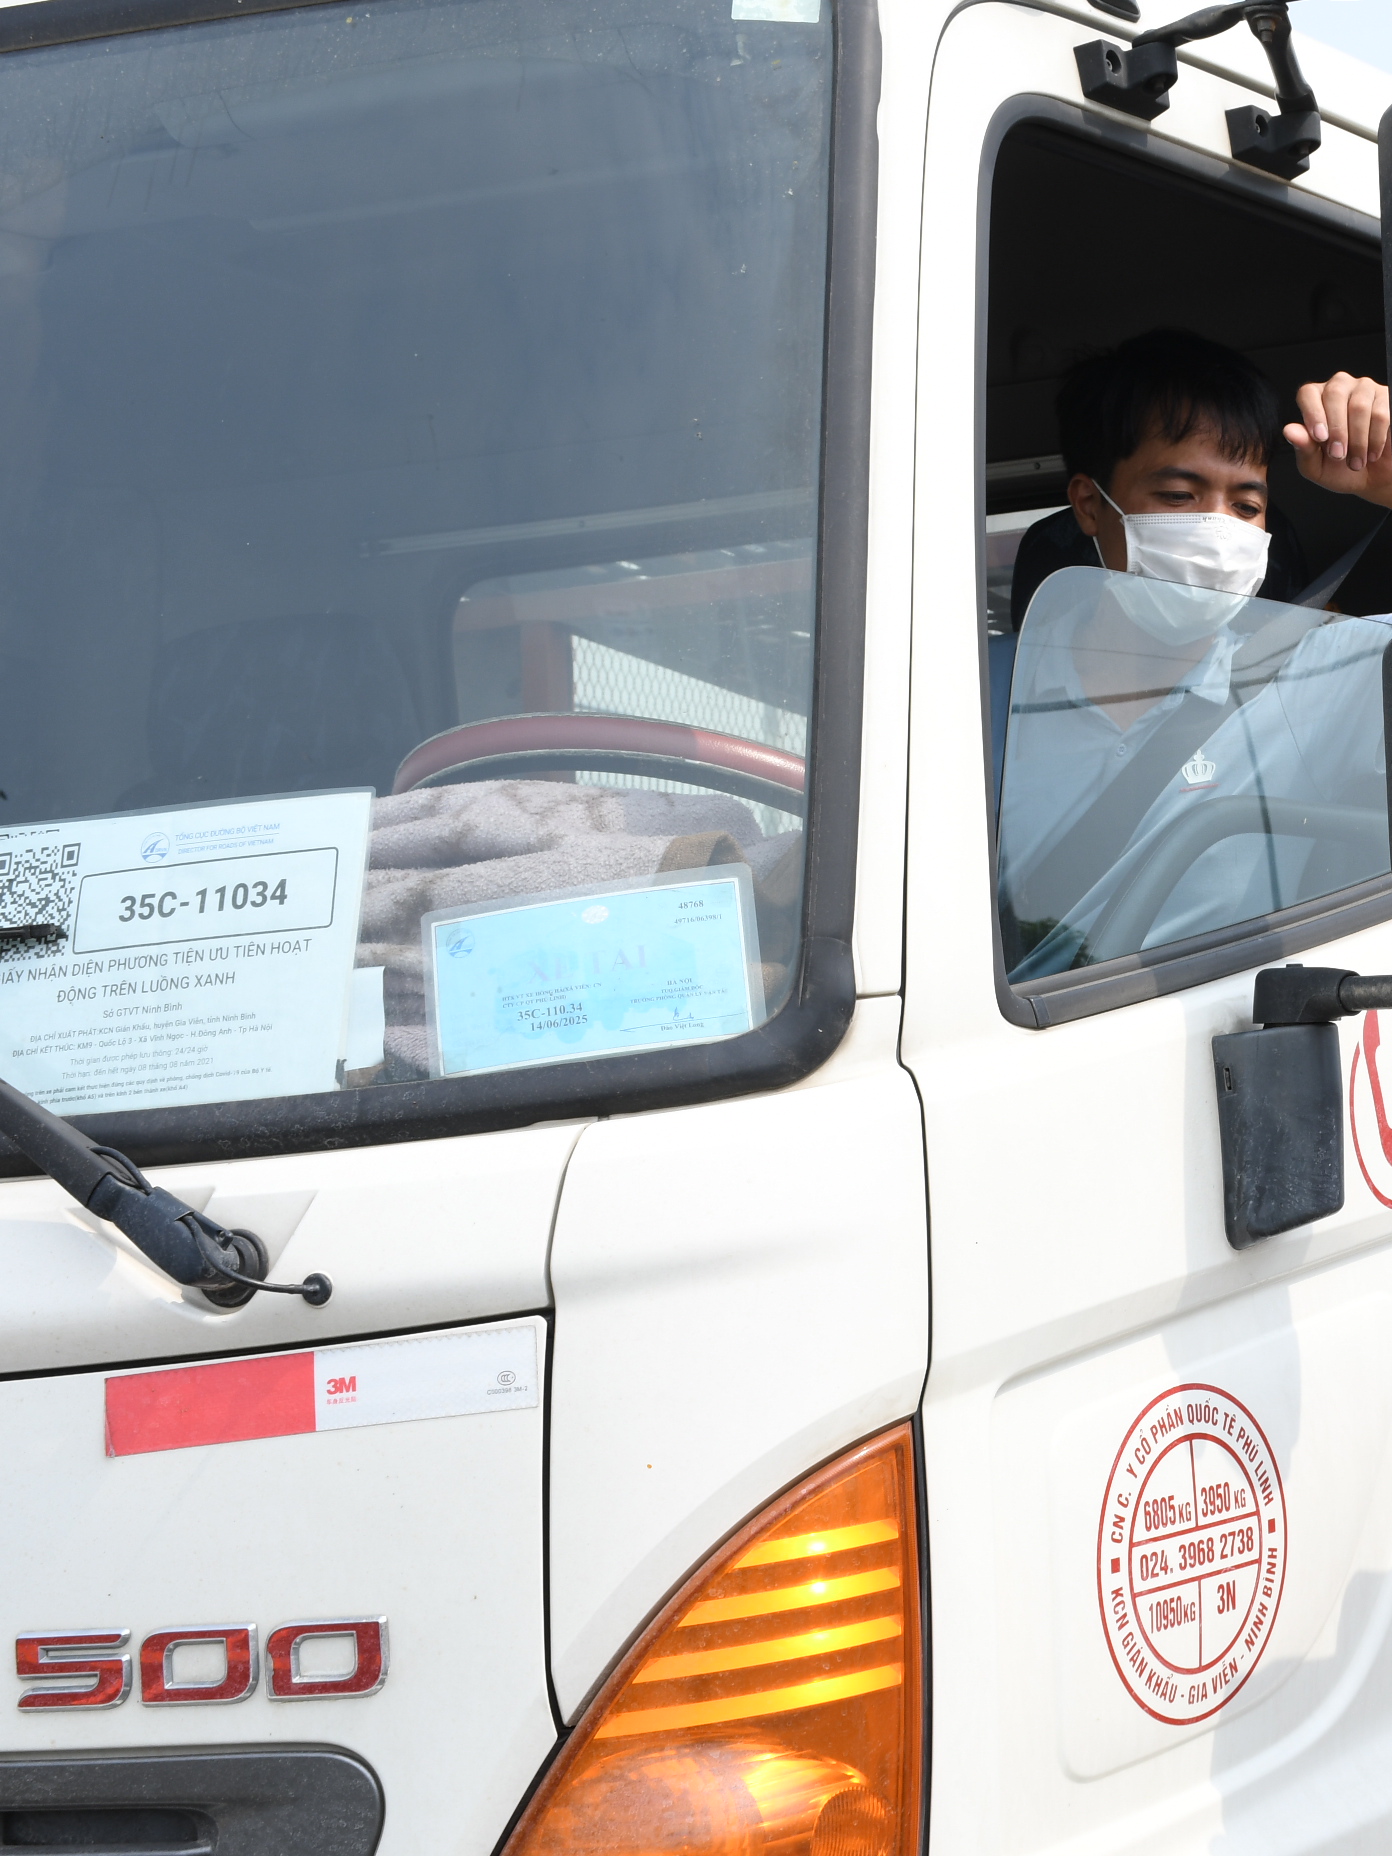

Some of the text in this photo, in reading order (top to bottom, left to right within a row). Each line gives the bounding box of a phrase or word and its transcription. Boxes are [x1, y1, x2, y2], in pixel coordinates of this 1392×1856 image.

[264, 823, 281, 832] NAM
[118, 878, 288, 923] 35C-11034
[677, 899, 705, 910] 48768
[1, 938, 312, 985] IẤY NHẬN DIỆN PHƯƠNG TIỆN ƯU TIÊN HOẠT
[56, 971, 236, 1006] ĐỘNG TRÊN LUỒNG XANH
[116, 1005, 140, 1018] GTVT
[141, 1005, 162, 1015] Ninh
[163, 1002, 183, 1012] Bình
[174, 1019, 187, 1027] Gia
[222, 1013, 239, 1022] Ninh
[516, 1001, 583, 1022] 35C-110.34
[530, 1013, 588, 1032] 14/06/2025
[77, 1041, 93, 1050] KM9
[218, 1027, 232, 1036] Anh
[239, 1026, 247, 1034] Tp
[248, 1024, 259, 1033] Hà
[175, 1046, 196, 1056] 24/24
[138, 1064, 147, 1073] 08
[169, 1060, 178, 1069] 08
[196, 1056, 215, 1066] 2021
[326, 1375, 357, 1396] 3M
[1111, 1513, 1126, 1544] CN
[1186, 1398, 1219, 1427] QUỐC
[1253, 1459, 1275, 1508] LINH
[1143, 1494, 1177, 1533] 6805
[1200, 1481, 1247, 1518] 3950 KG
[1178, 1537, 1215, 1572] 3968
[1219, 1526, 1254, 1561] 2738
[1216, 1579, 1237, 1615] 3N
[1111, 1587, 1130, 1631] KCN
[1187, 1682, 1209, 1705] GIA
[1244, 1602, 1268, 1653] NINH
[1262, 1547, 1278, 1599] BÌNH
[1148, 1595, 1182, 1635] 10950
[15, 1614, 390, 1713] 500
